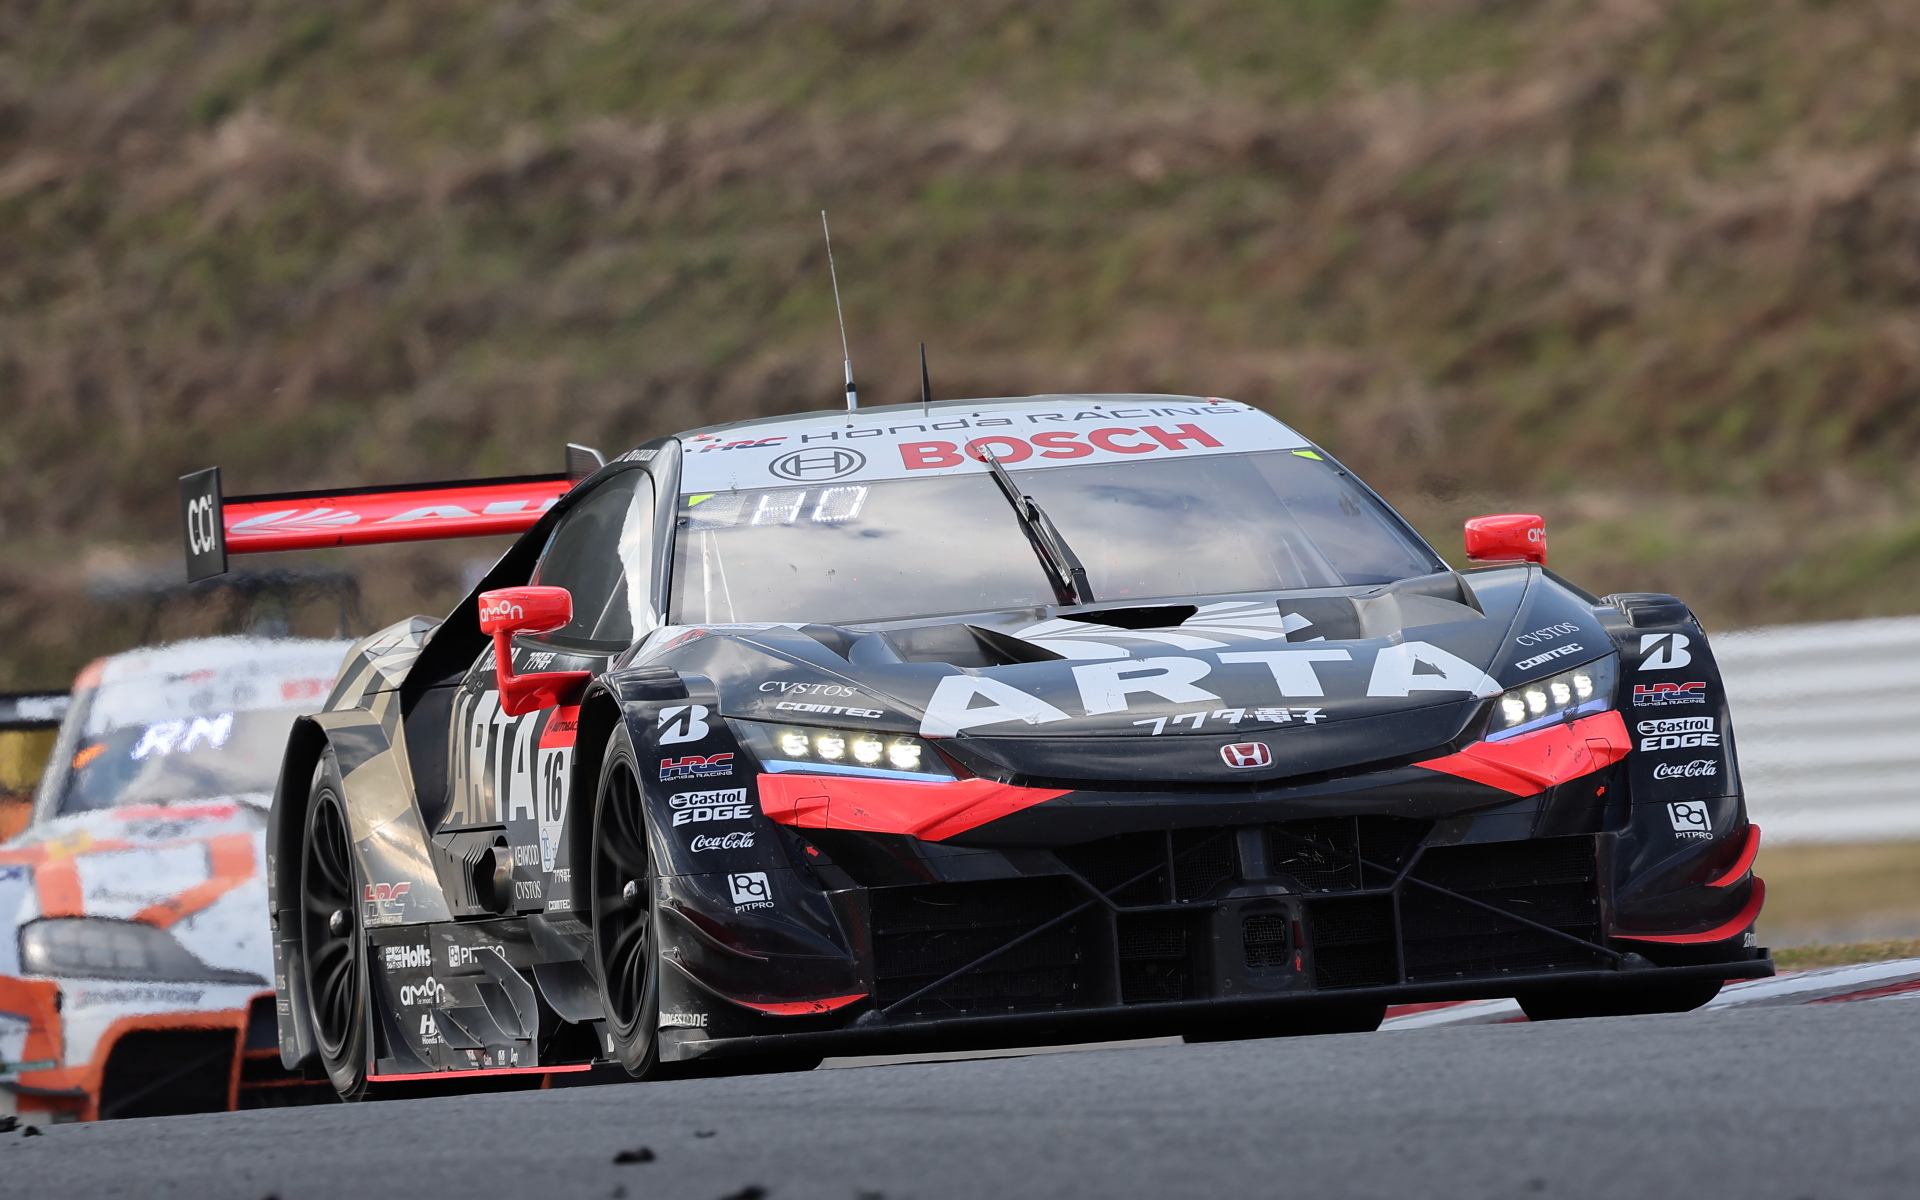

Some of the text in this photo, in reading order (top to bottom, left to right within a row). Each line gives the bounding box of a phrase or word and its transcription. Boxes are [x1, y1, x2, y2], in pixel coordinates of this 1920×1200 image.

[802, 414, 1012, 443] Honda
[1025, 405, 1242, 423] RACING
[898, 423, 1225, 470] BOSCH
[1516, 622, 1580, 646] CVSTOS
[1515, 643, 1584, 671] COMTEC
[758, 681, 859, 698] CVSTOS
[919, 640, 1504, 738] ARTA
[1633, 682, 1706, 703] HRC
[776, 701, 883, 719] COMTEC
[1657, 718, 1710, 733] Castrol
[1641, 732, 1721, 752] EDGE
[659, 752, 734, 778] HRC
[1653, 759, 1718, 780] Coca-Cola
[544, 750, 564, 822] 16
[688, 789, 743, 806] Castrol
[672, 804, 754, 827] EDGE
[690, 831, 756, 853] Coca-Cola
[1675, 831, 1713, 840] PITPRO
[734, 901, 775, 914] PITPRO
[401, 944, 431, 968] Holts
[400, 976, 446, 1006] amon
